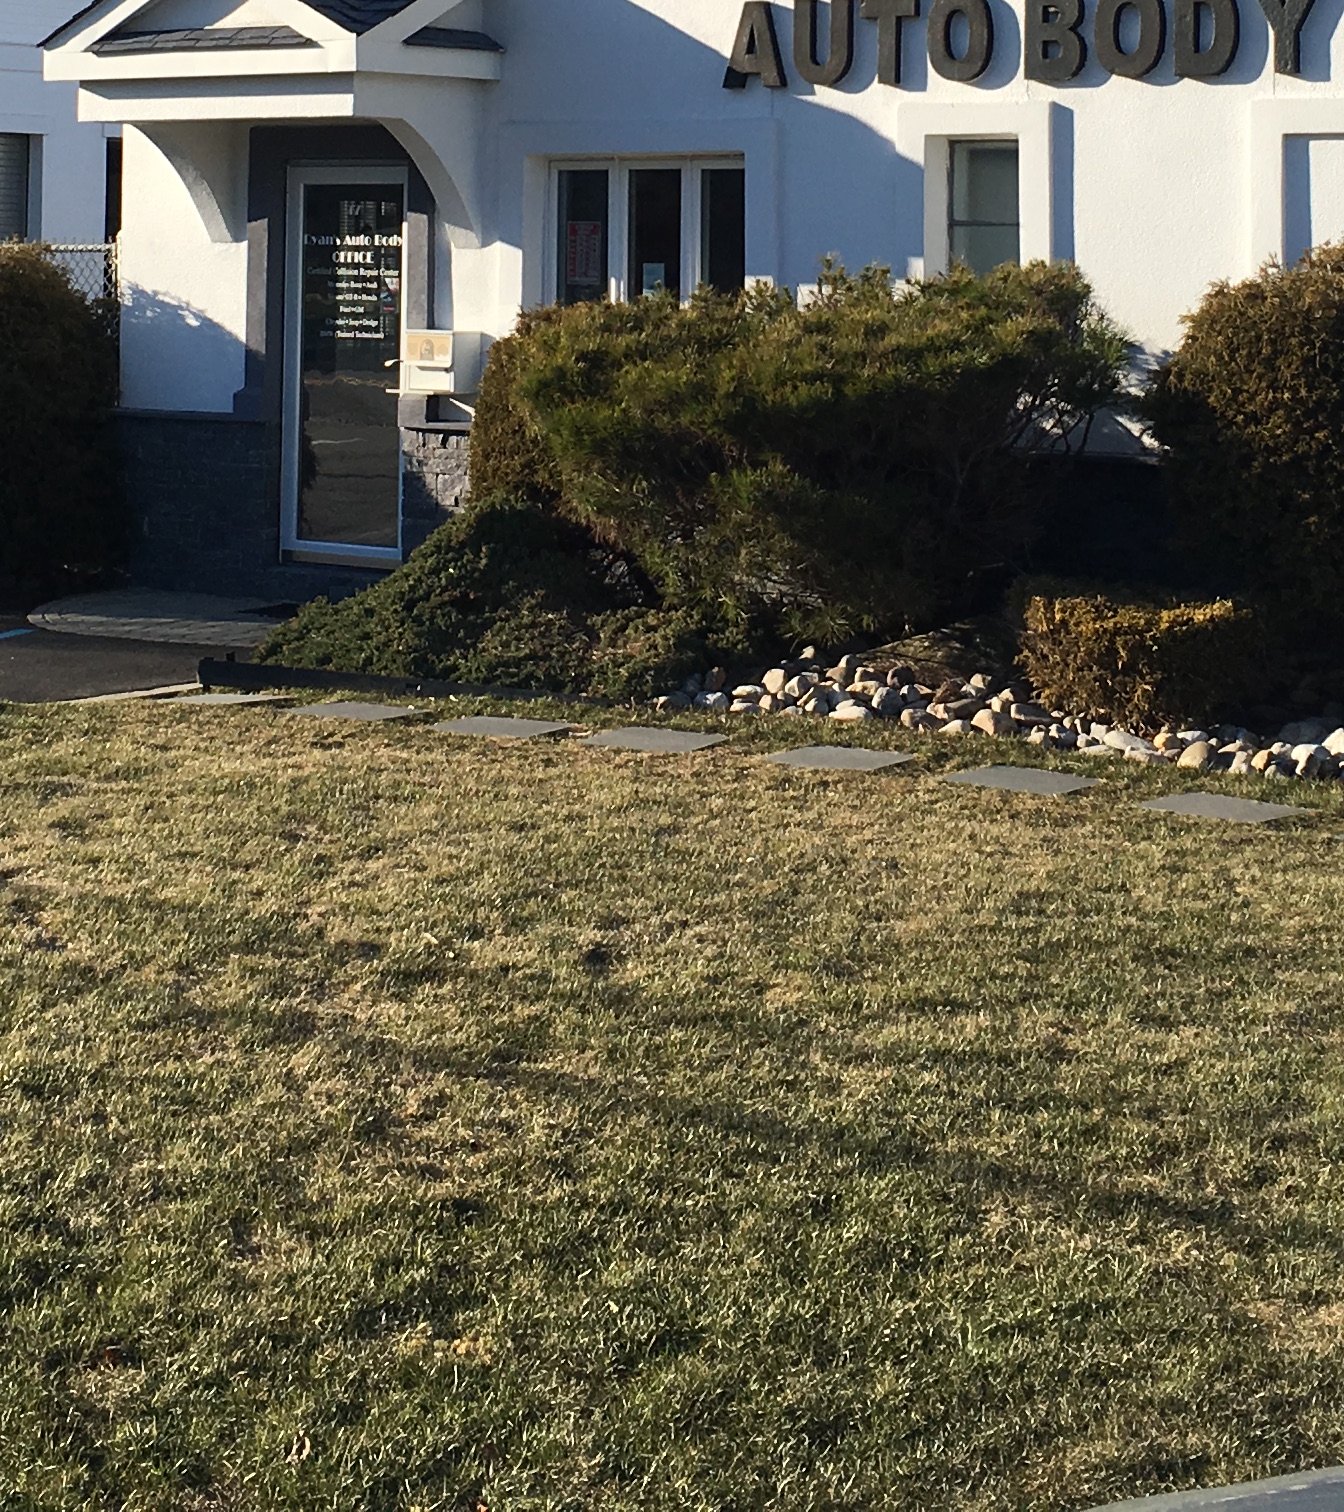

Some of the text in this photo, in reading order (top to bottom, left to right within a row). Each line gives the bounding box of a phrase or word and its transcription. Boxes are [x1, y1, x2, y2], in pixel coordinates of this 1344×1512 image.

[342, 234, 372, 246] Auto
[374, 234, 403, 247] Body
[332, 251, 374, 263] OFFICE
